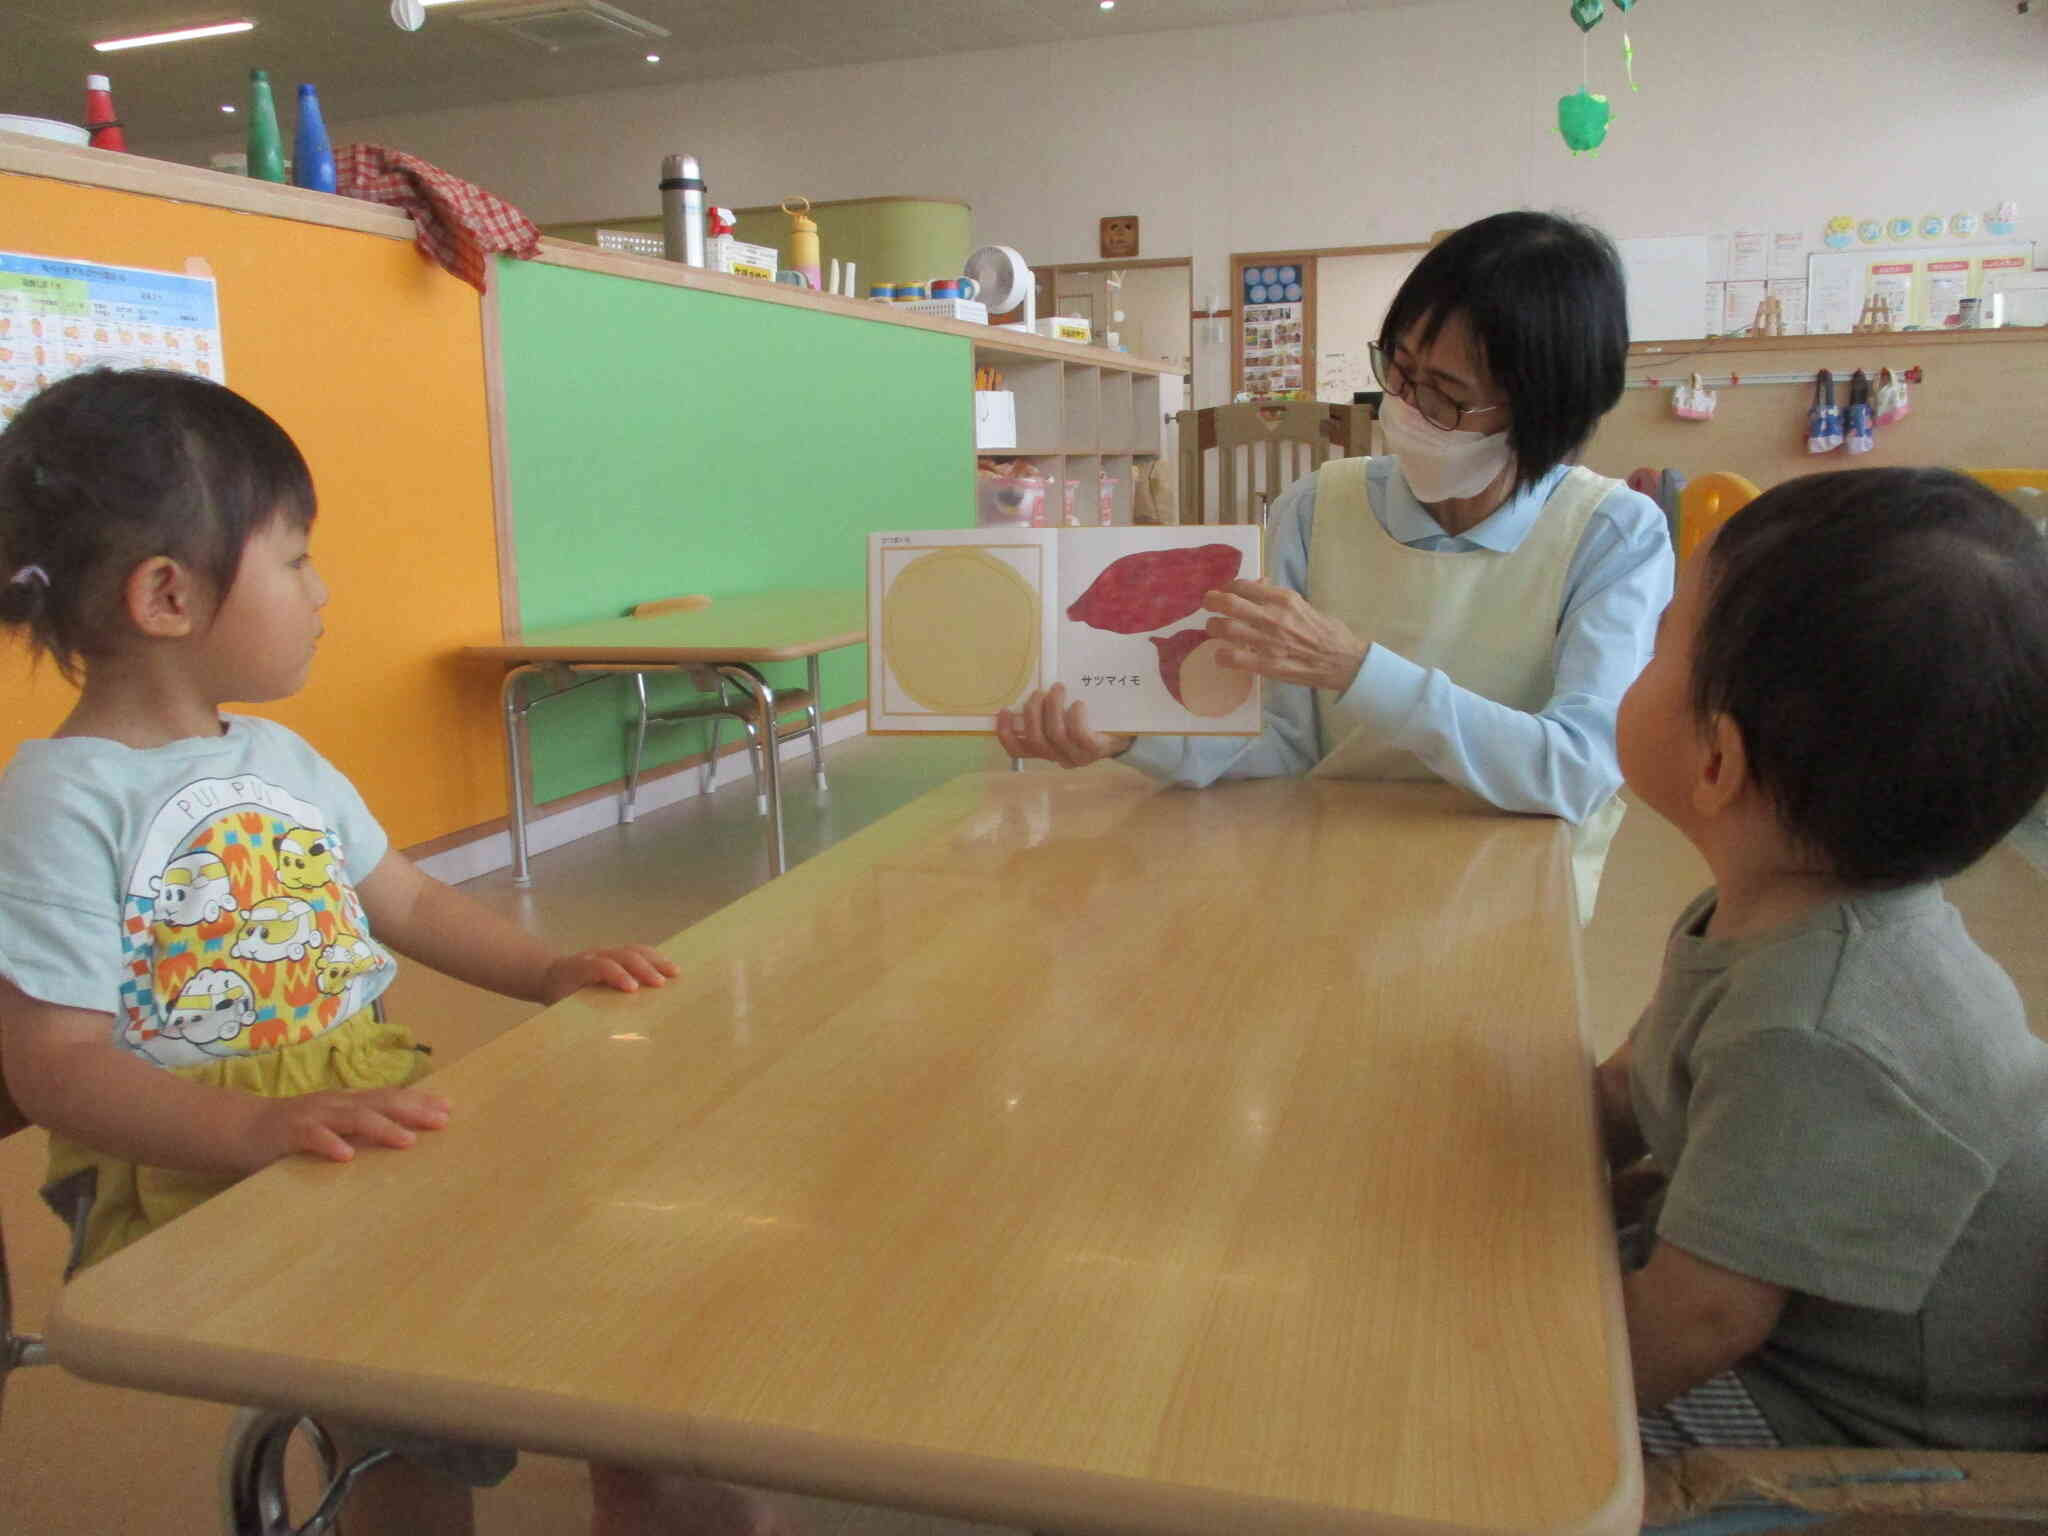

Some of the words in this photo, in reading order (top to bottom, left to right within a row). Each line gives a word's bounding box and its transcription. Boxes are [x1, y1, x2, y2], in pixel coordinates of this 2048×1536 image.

[1081, 674, 1141, 687] サツマイモ
[176, 785, 218, 820] PUI
